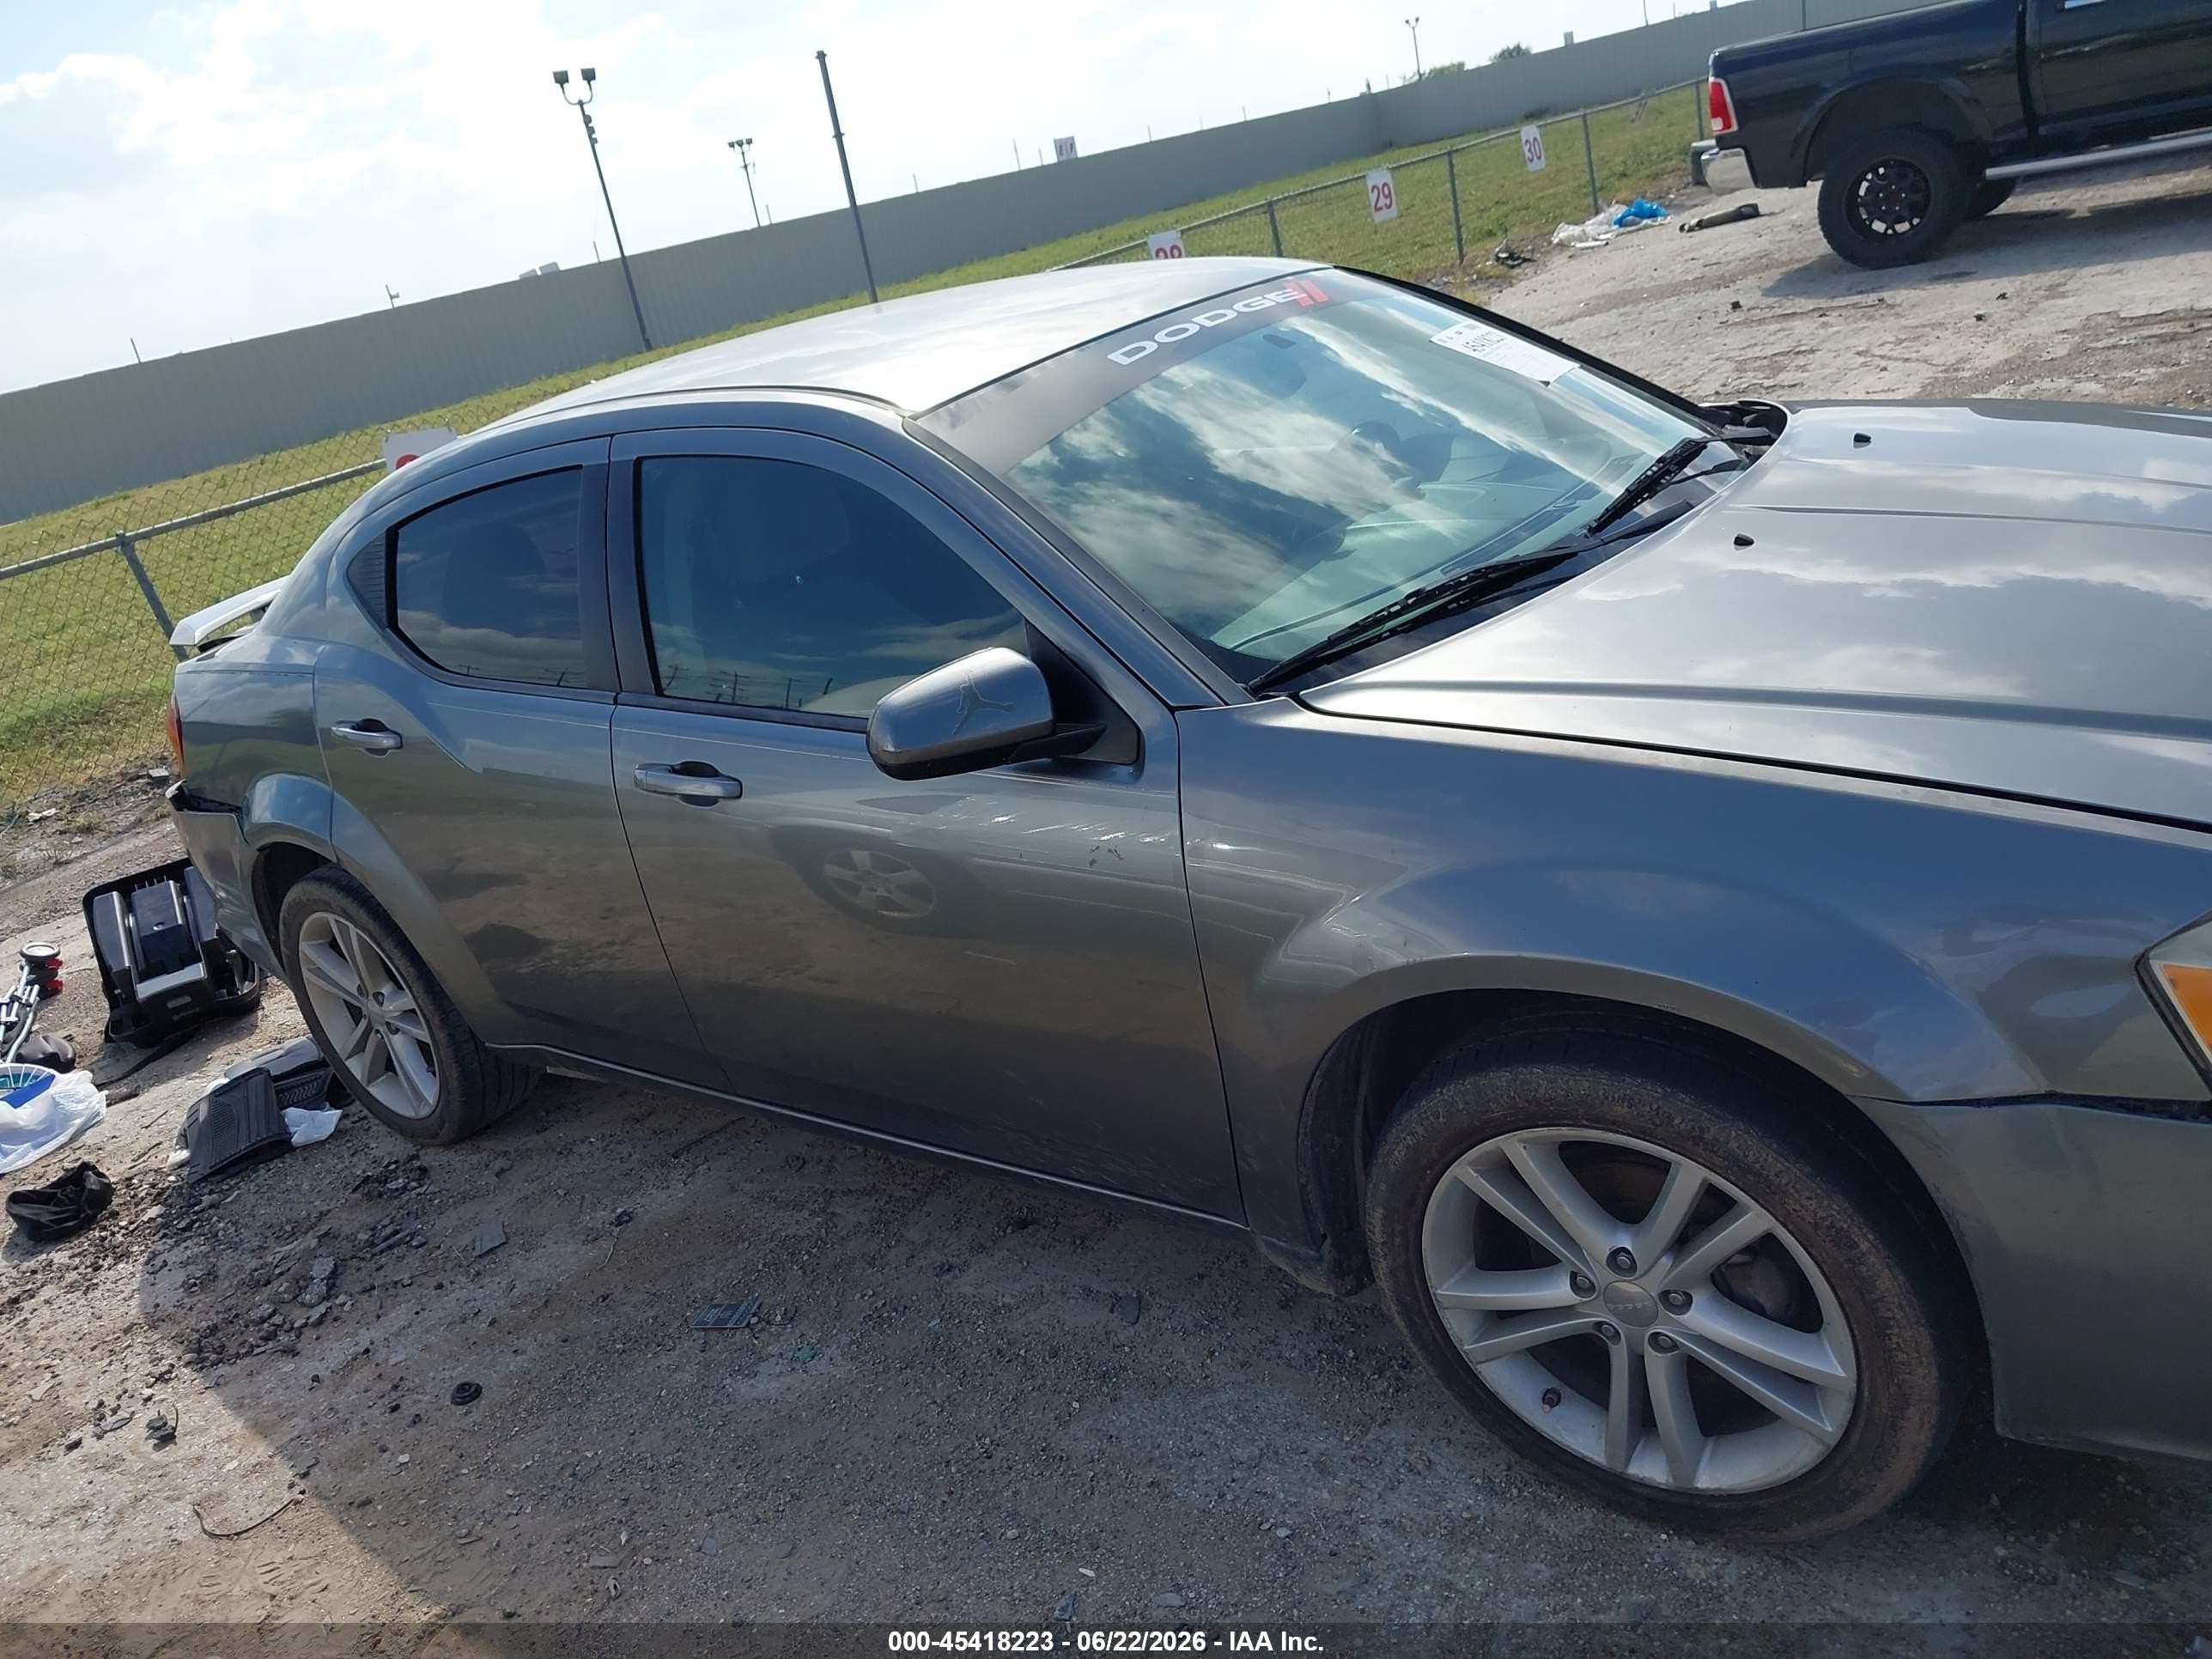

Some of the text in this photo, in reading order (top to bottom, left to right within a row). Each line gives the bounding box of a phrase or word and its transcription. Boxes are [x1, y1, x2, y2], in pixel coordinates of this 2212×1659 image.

[1524, 137, 1542, 163] 30
[1370, 182, 1394, 212] 29
[1107, 288, 1307, 366] DODGE
